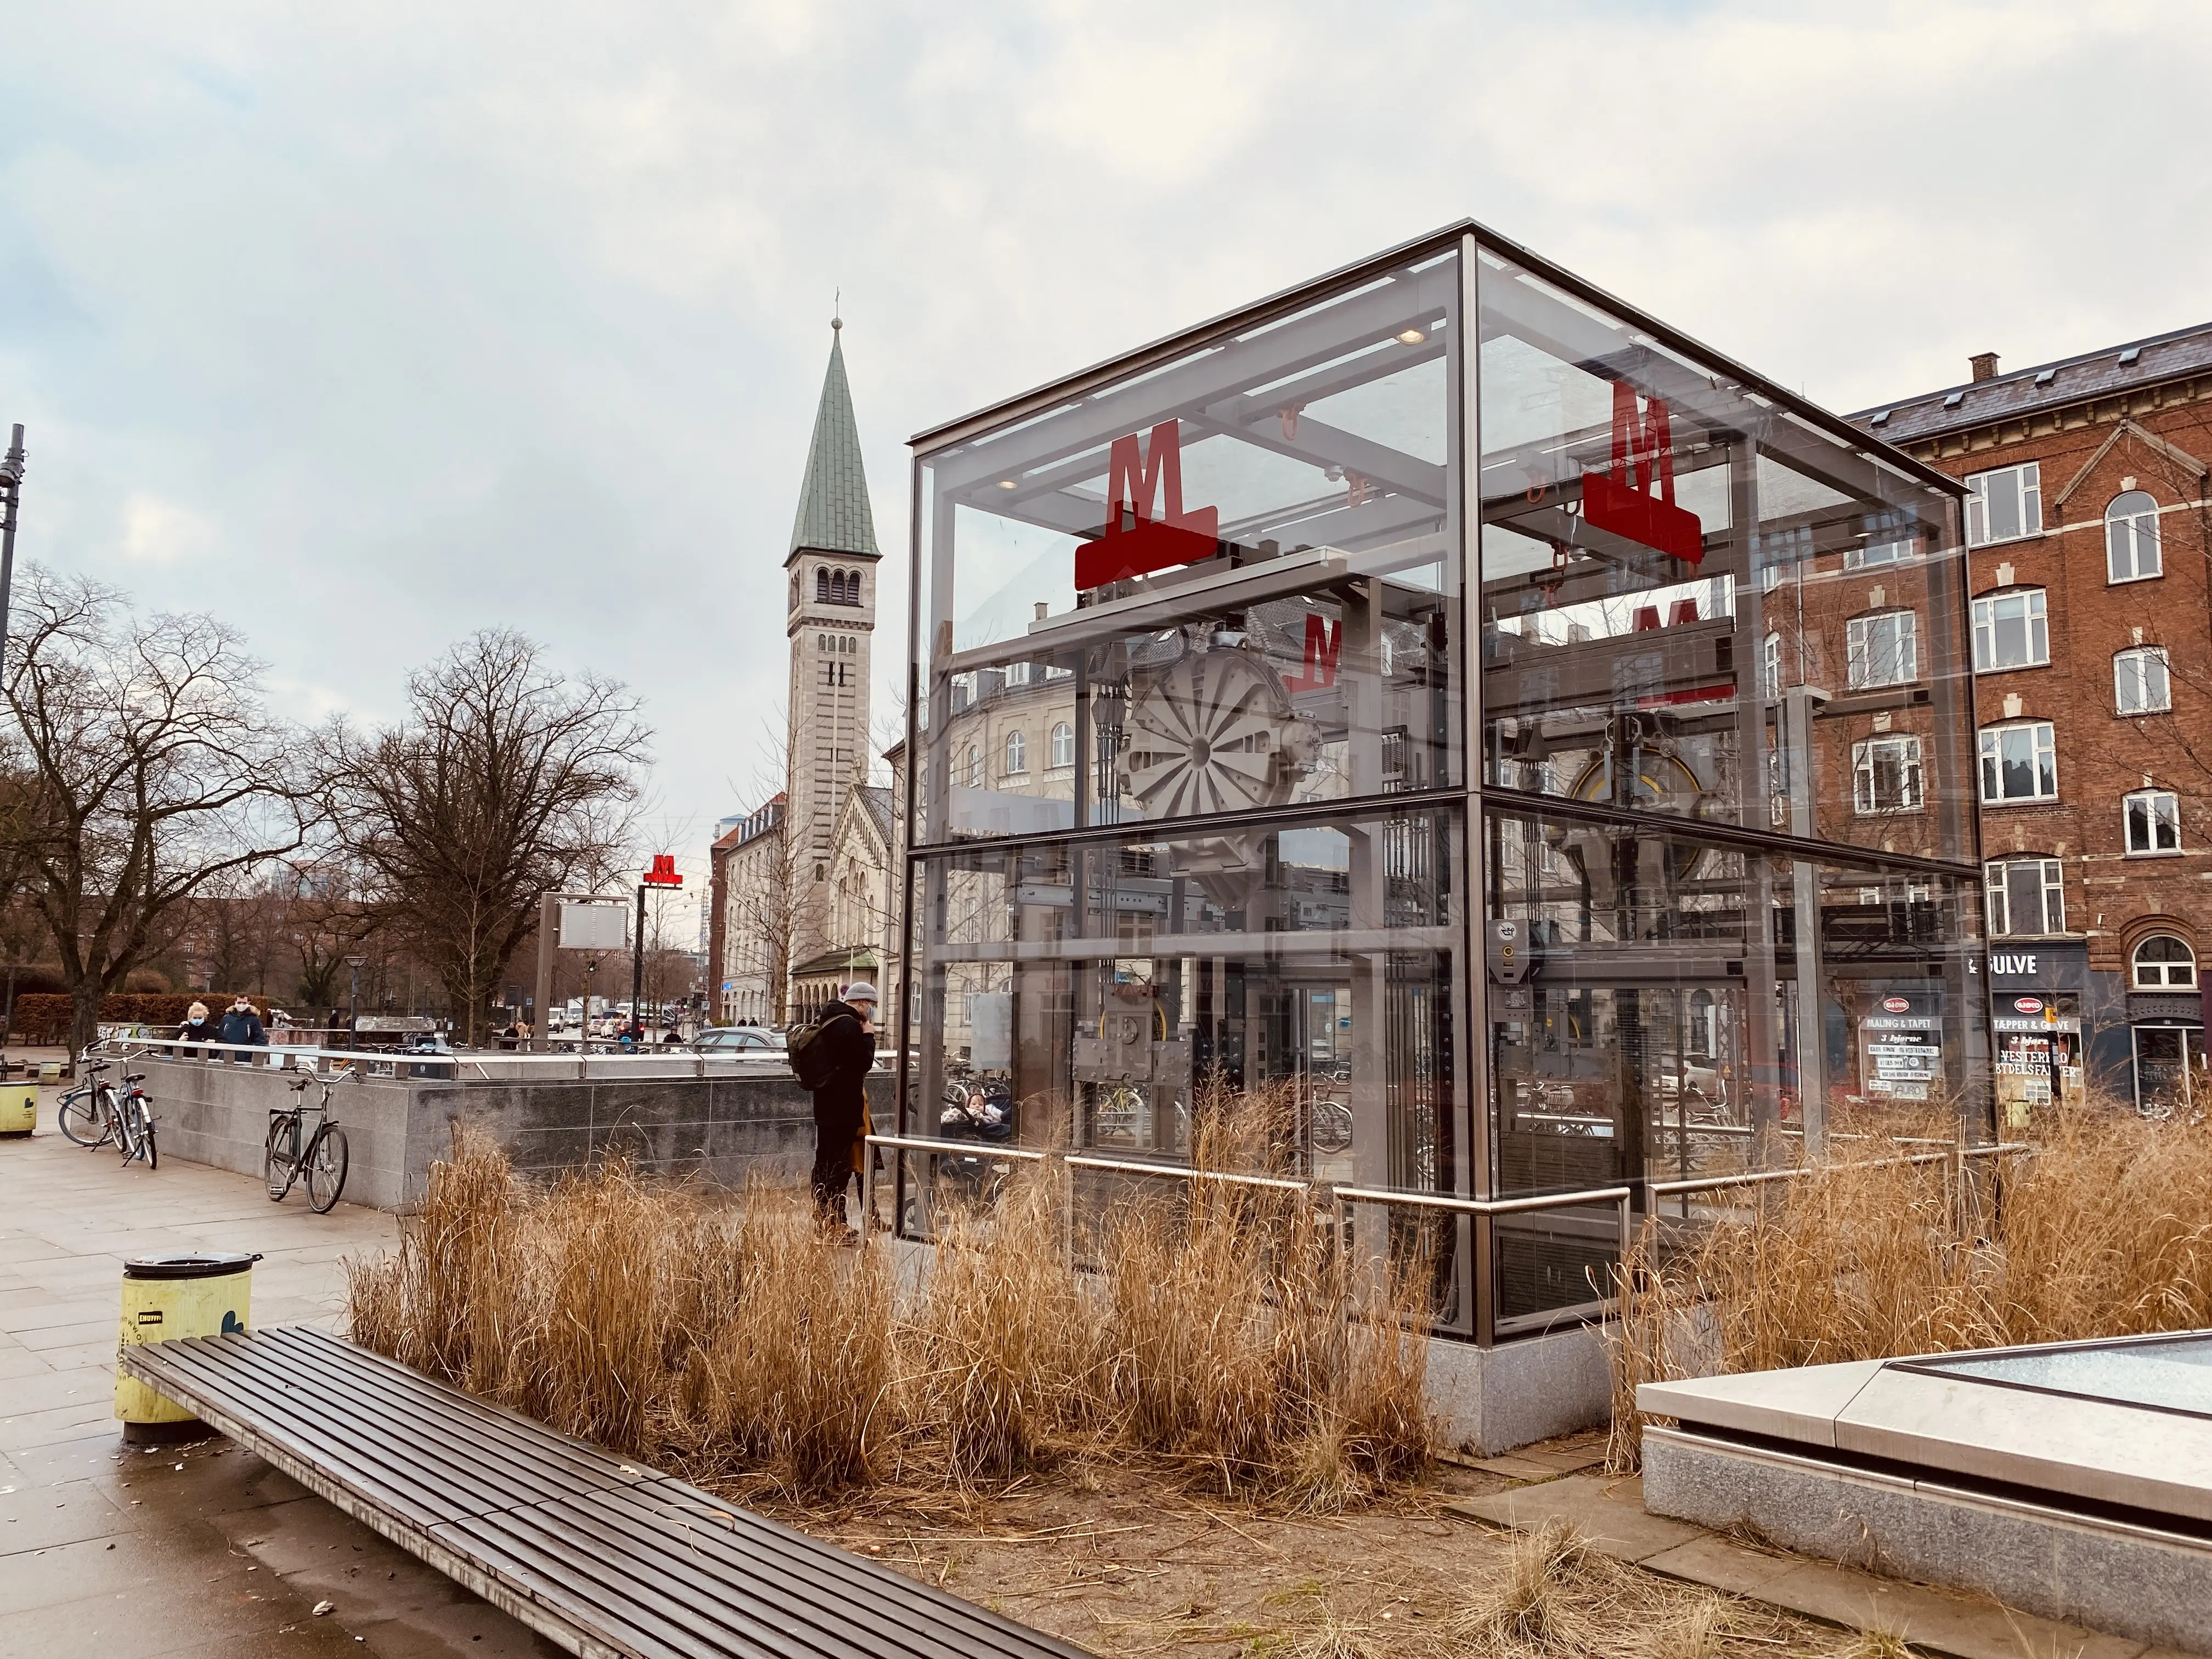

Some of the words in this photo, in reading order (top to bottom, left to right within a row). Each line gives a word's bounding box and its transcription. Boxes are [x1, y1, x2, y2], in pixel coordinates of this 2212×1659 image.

[1867, 1019, 1899, 1028] MALING
[1900, 1020, 1906, 1028] &
[1908, 1019, 1931, 1028] TAPET
[1993, 1020, 2028, 1030] TÆPPER
[2030, 1020, 2038, 1030] &
[2040, 1020, 2069, 1030] GVE
[1881, 1034, 1887, 1042] 3
[2011, 1036, 2019, 1045] 3
[2021, 1036, 2049, 1046] bjørn
[1995, 1063, 2076, 1077] BYDELSFAER
